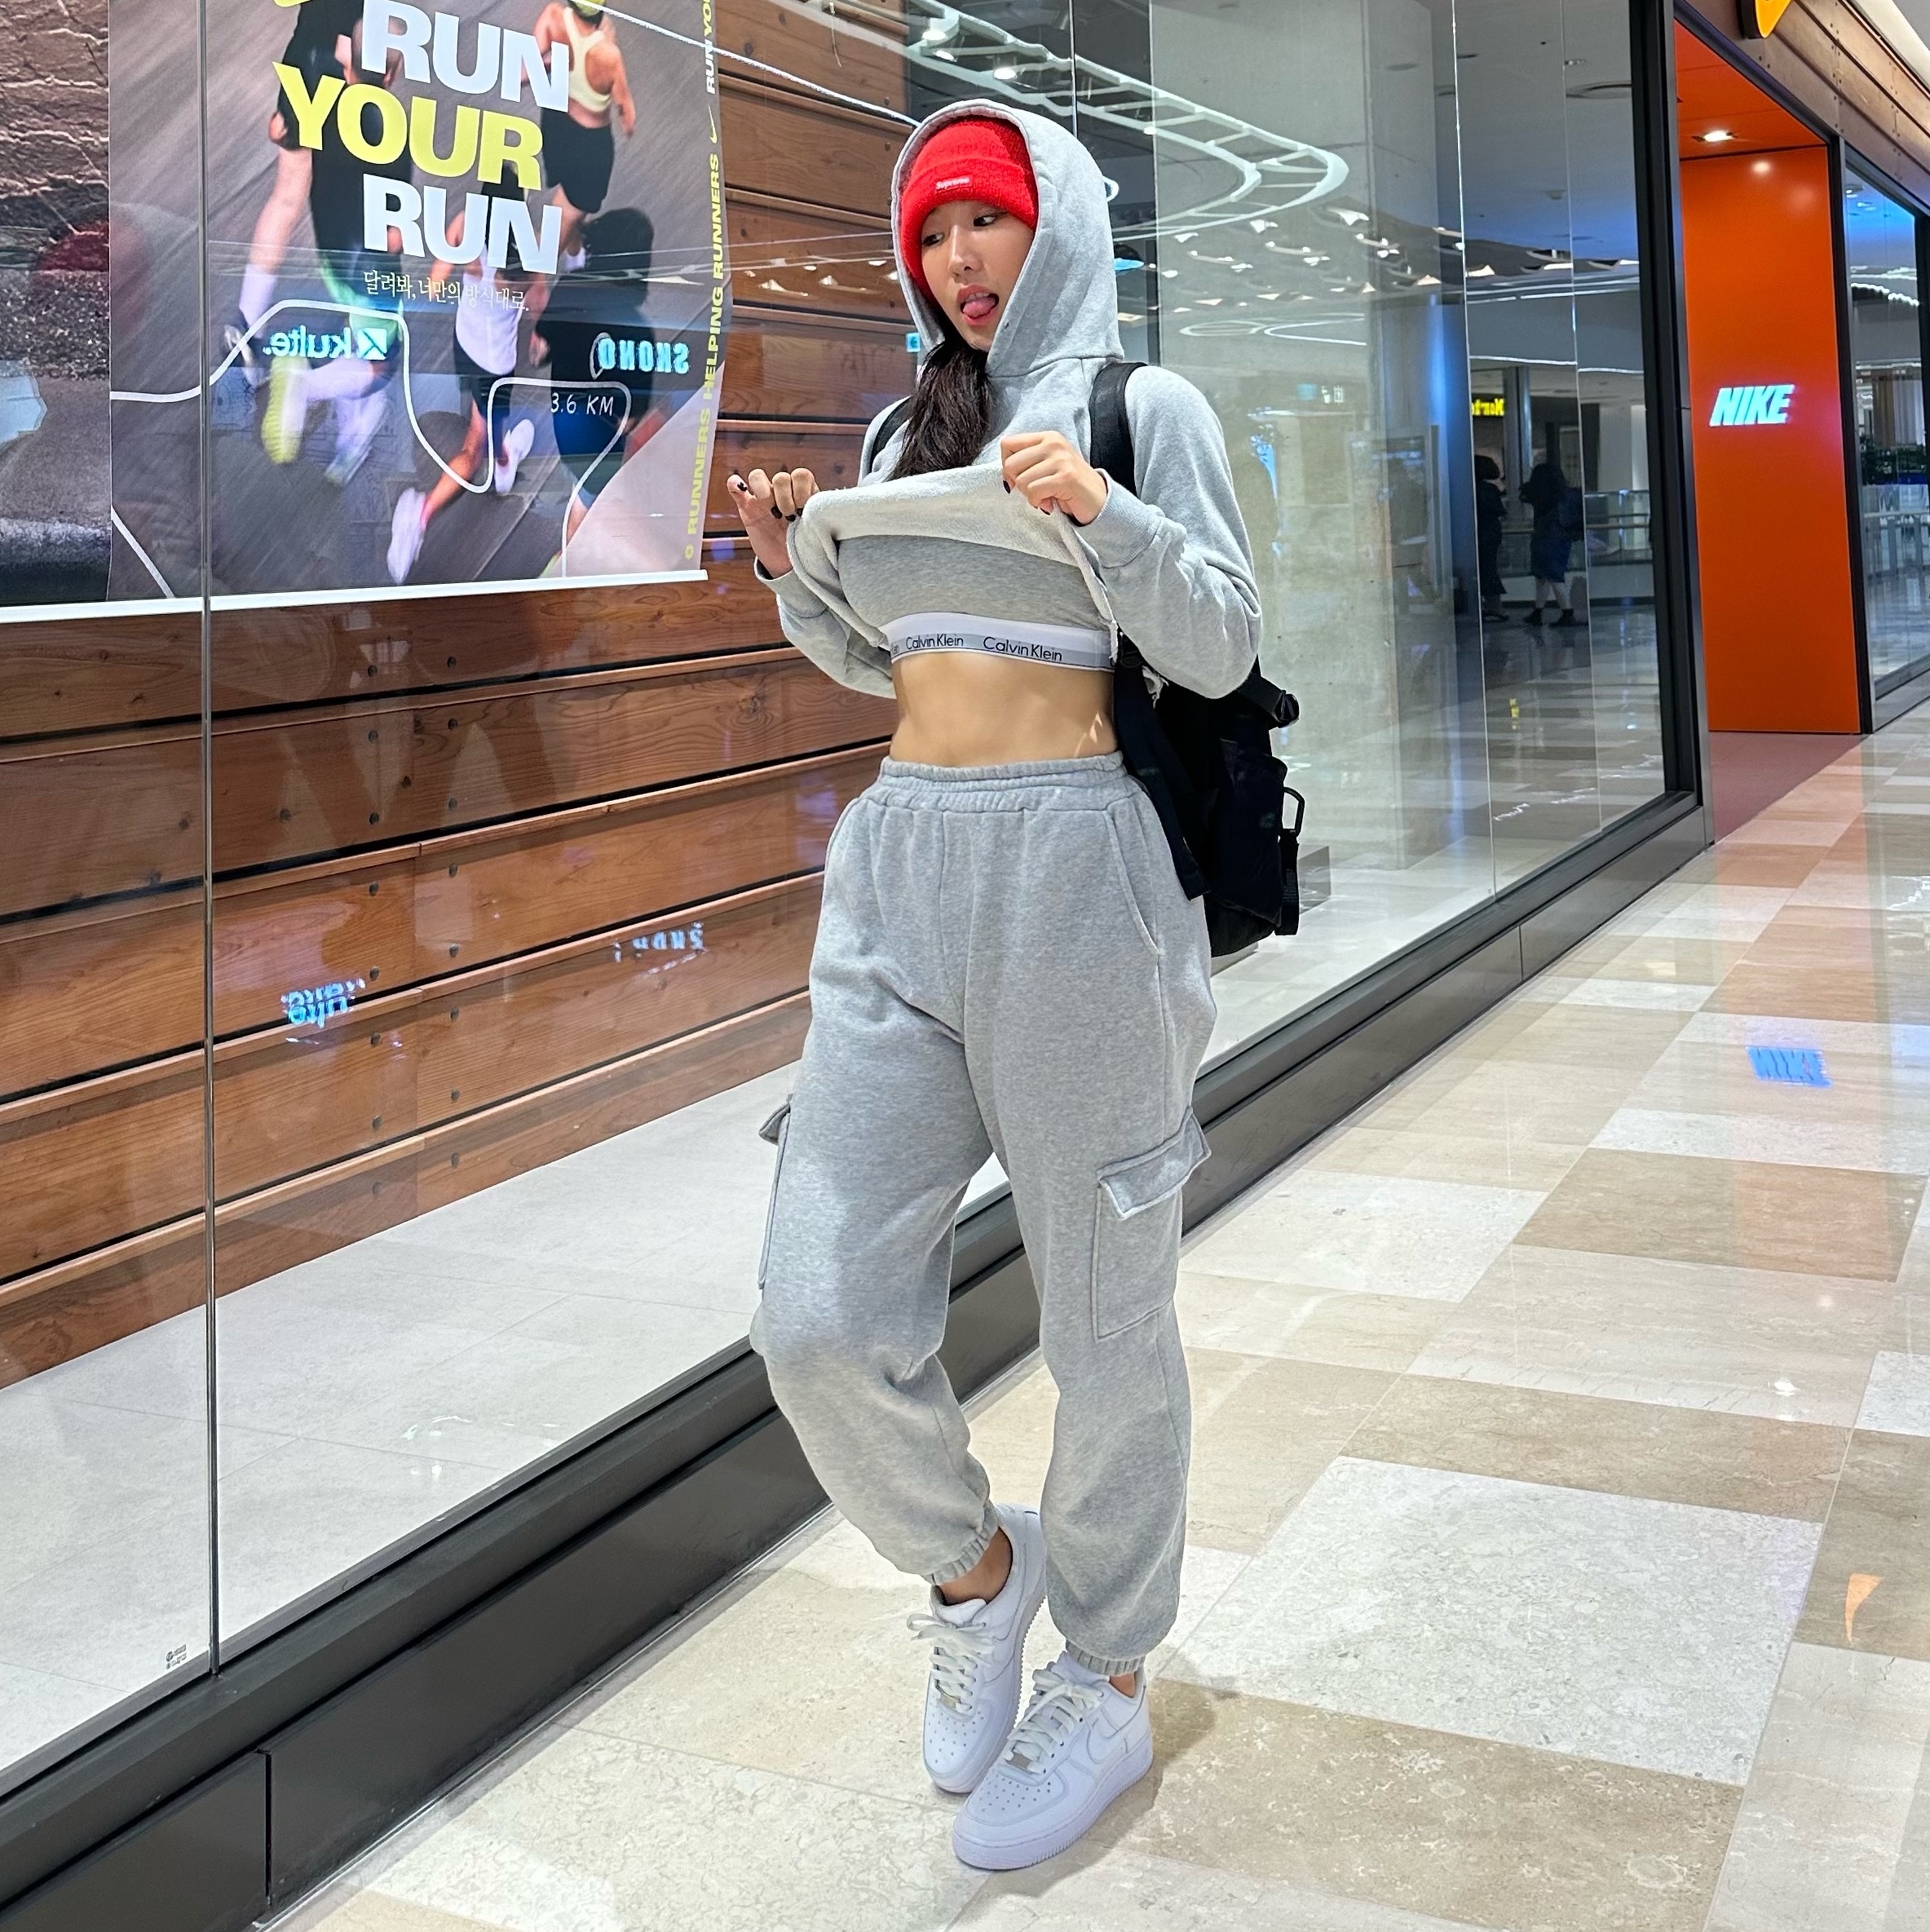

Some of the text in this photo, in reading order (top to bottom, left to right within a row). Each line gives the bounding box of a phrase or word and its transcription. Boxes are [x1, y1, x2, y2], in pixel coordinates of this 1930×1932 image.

[361, 0, 569, 113] RUN
[272, 61, 543, 191] YOUR
[363, 173, 563, 275] RUN
[364, 269, 529, 312] 달려봐, 너만의 방식대로.
[687, 0, 724, 535] RUNNERS HELPING RUNNERS RUN YO
[550, 391, 614, 417] 3.6 KM
[1709, 383, 1795, 427] NIKE
[906, 634, 935, 650] Calvin
[937, 633, 964, 647] Klein
[983, 636, 1028, 656] Calvin
[1031, 643, 1062, 662] Klein
